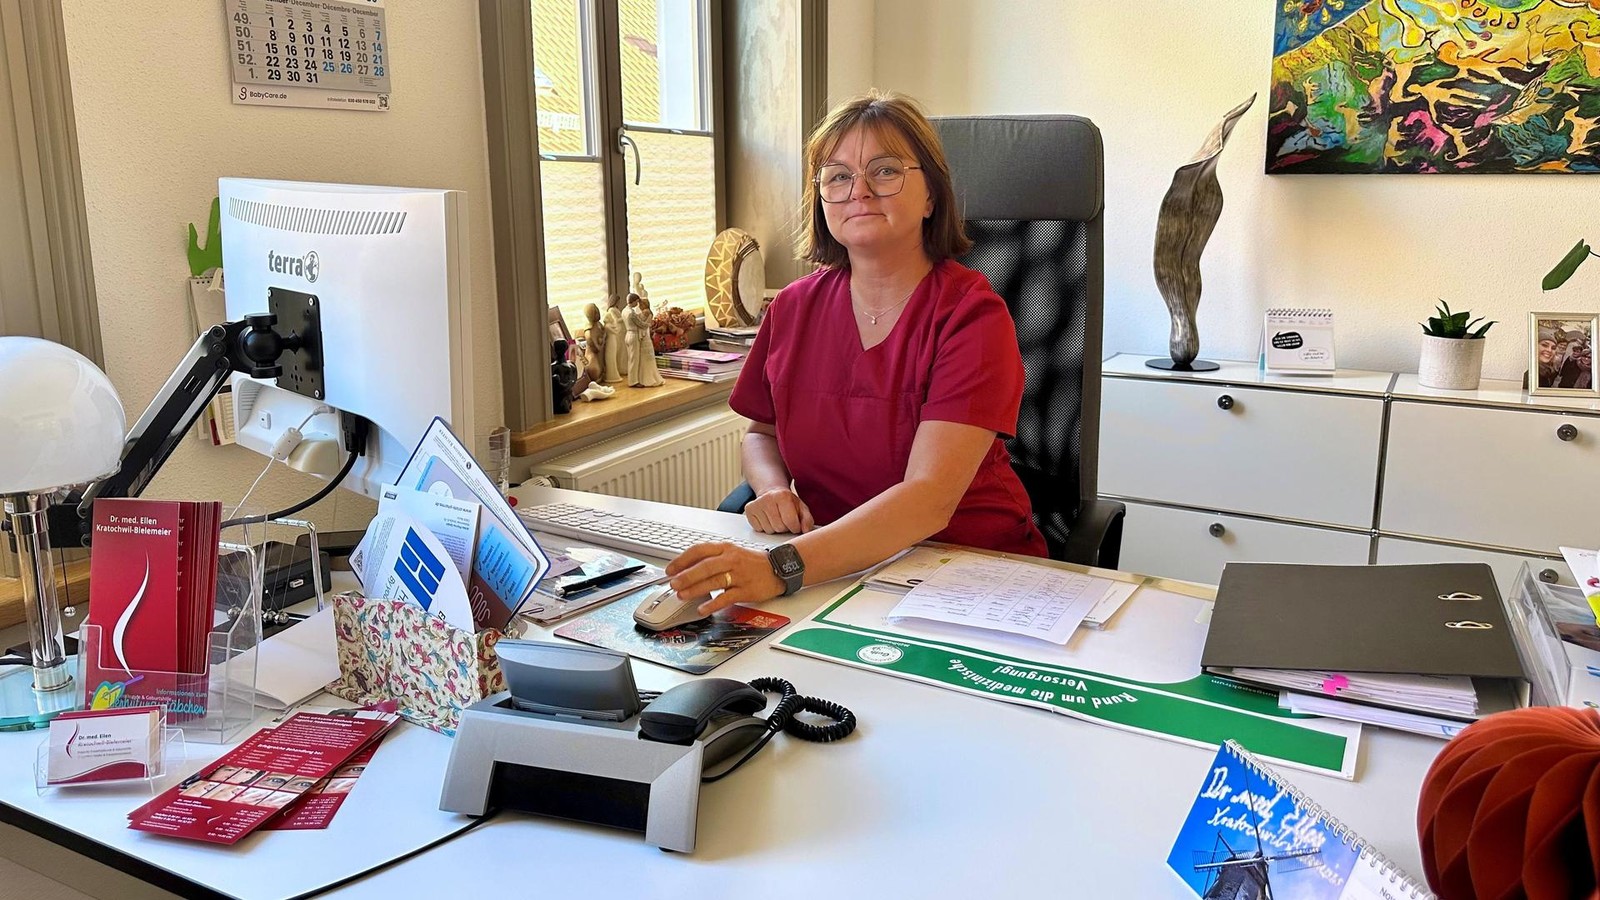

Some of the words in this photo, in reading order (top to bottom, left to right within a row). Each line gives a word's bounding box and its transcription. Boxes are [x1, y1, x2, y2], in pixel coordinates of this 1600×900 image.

[234, 12, 251, 25] 49.
[269, 17, 274, 27] 1
[287, 19, 294, 30] 2
[306, 22, 312, 32] 3
[324, 24, 331, 34] 4
[342, 26, 348, 36] 5
[360, 28, 365, 39] 6
[375, 31, 380, 40] 7
[235, 26, 253, 38] 50.
[270, 30, 276, 40] 8
[289, 32, 296, 43] 9
[302, 34, 314, 45] 10
[321, 36, 331, 47] 11
[339, 38, 350, 49] 12
[356, 40, 366, 51] 13
[372, 42, 382, 52] 14
[237, 40, 255, 52] 51.
[265, 42, 278, 54] 15
[285, 45, 297, 56] 16
[304, 47, 315, 57] 17
[322, 49, 333, 59] 18
[340, 51, 351, 61] 19
[356, 52, 368, 63] 20
[372, 54, 383, 65] 21
[238, 53, 256, 65] 52.
[266, 56, 280, 67] 22
[285, 58, 298, 69] 23
[304, 60, 317, 70] 24
[322, 61, 334, 72] 25
[340, 63, 352, 73] 26
[357, 65, 368, 75] 27
[374, 66, 384, 76] 28
[249, 68, 258, 78] 1.
[267, 69, 281, 80] 29
[287, 71, 300, 82] 30
[306, 73, 318, 83] 31
[250, 91, 287, 99] BabyCare.de
[268, 250, 303, 276] terra
[110, 515, 120, 523] Dr.
[122, 516, 139, 524] med.
[140, 517, 157, 525] Ellen
[96, 524, 172, 536] Kratochwil-Bielemeier
[948, 659, 1027, 695] medizinische
[992, 666, 1088, 692] Versorgung!
[1030, 689, 1055, 701] die
[1211, 679, 1278, 698] tungsspektrum
[1061, 694, 1086, 704] um
[1091, 692, 1138, 708] Rund
